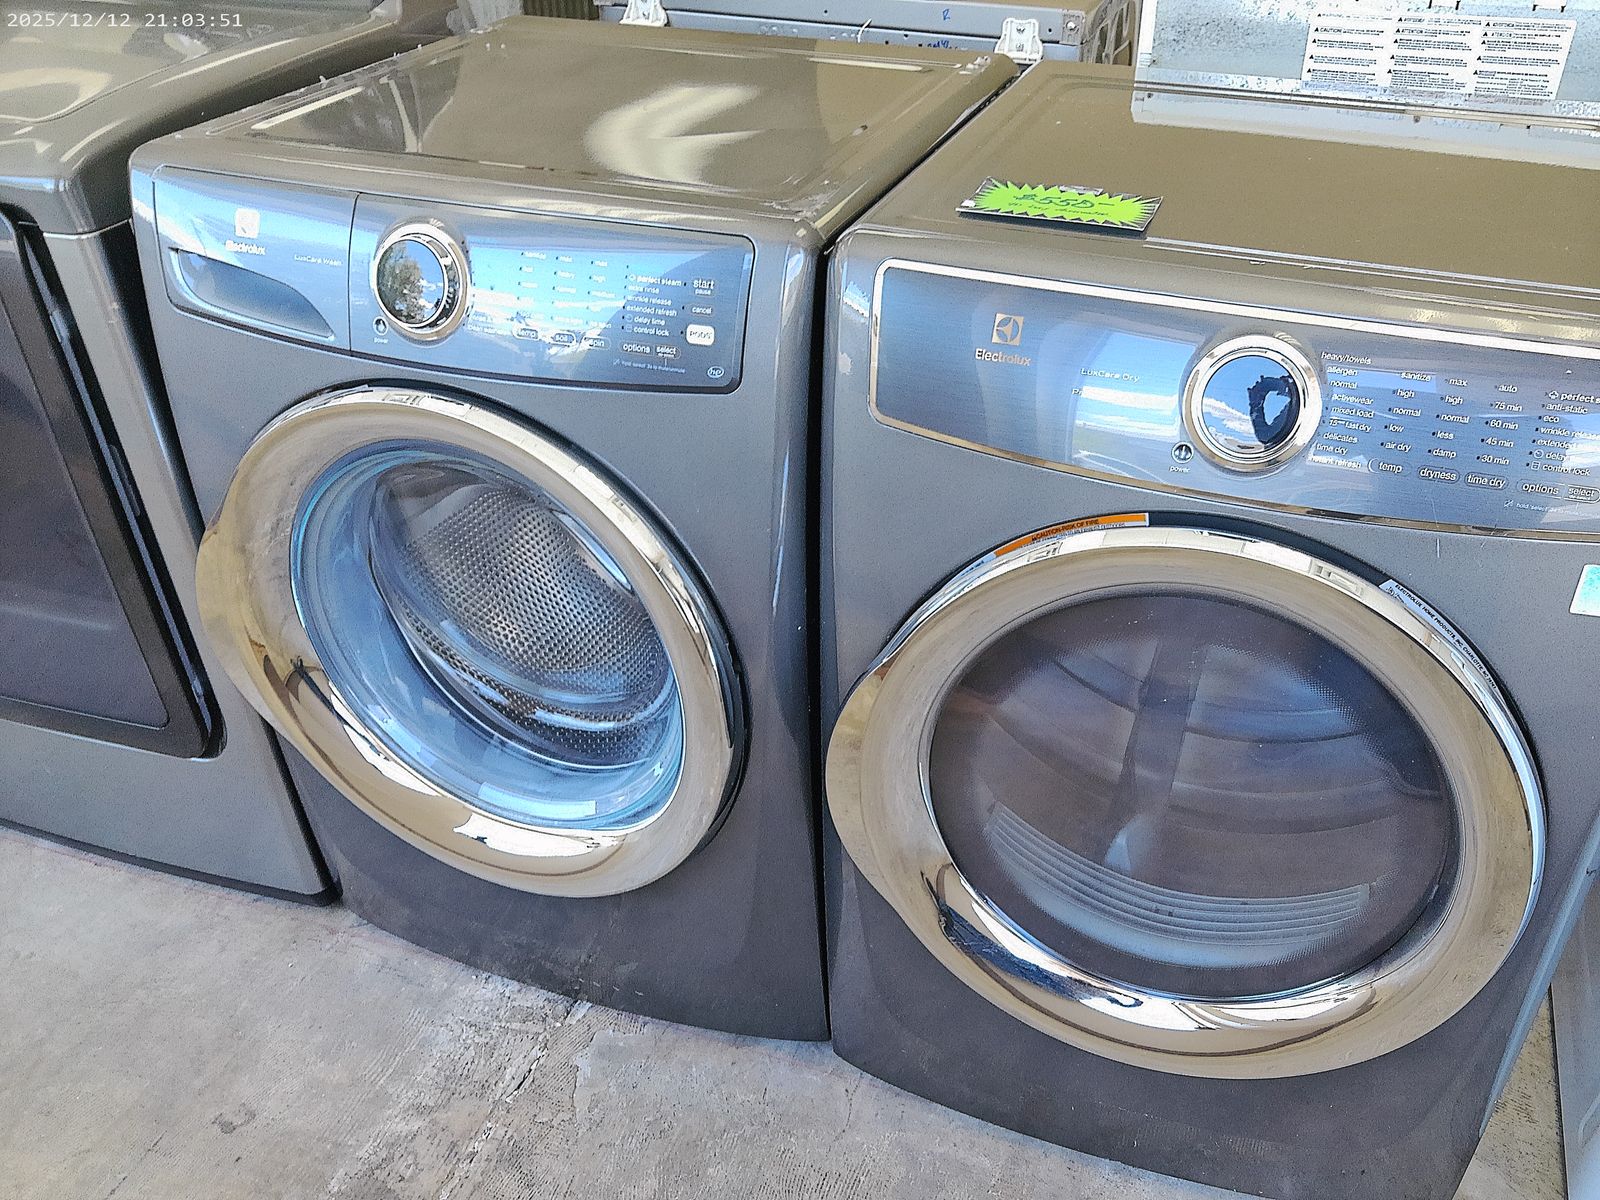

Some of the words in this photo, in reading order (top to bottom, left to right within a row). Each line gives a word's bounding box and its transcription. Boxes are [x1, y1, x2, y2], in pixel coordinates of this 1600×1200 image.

[693, 279, 715, 290] start
[626, 304, 655, 314] extended
[656, 307, 677, 317] refresh
[692, 306, 712, 315] cancel
[634, 316, 651, 326] delay
[633, 326, 655, 336] control
[656, 328, 669, 337] lock
[622, 342, 651, 354] options
[656, 345, 677, 355] select
[975, 348, 1032, 367] Electrolux
[1321, 351, 1372, 366] heavy/towels
[1081, 367, 1120, 380] LuxCare
[1122, 373, 1141, 383] Dry
[1327, 366, 1358, 377] allergen
[1401, 371, 1431, 382] sanitize
[1330, 380, 1358, 390] normal
[1449, 378, 1468, 387] max
[1397, 388, 1415, 399] high
[1498, 384, 1518, 394] auto
[1331, 393, 1374, 406] activewear
[1444, 395, 1463, 405] high
[1560, 392, 1594, 404] perfect
[1331, 406, 1356, 417] mixed
[1356, 409, 1375, 419] load
[1393, 407, 1421, 417] normal
[1494, 402, 1506, 410] 75
[1506, 403, 1523, 412] min
[1546, 403, 1588, 415] anti-static
[1440, 414, 1470, 424] normal
[1543, 414, 1560, 423] eco
[1389, 423, 1405, 433] low
[1490, 419, 1501, 428] 60
[1502, 421, 1519, 430] min
[1436, 431, 1454, 440] less
[1540, 426, 1570, 437] wrinkle
[1323, 431, 1358, 444] delicates
[1485, 437, 1497, 446] 45
[1498, 438, 1514, 448] min
[1316, 443, 1333, 452] time
[1334, 446, 1349, 456] dry
[1385, 441, 1396, 450] air
[1397, 443, 1411, 453] dry
[1432, 448, 1457, 459] damp
[1481, 454, 1493, 463] 30
[1493, 456, 1510, 465] min
[1379, 462, 1403, 474] temp
[1542, 463, 1572, 474] control
[1572, 466, 1590, 476] lock
[1420, 467, 1457, 481] dryness
[1467, 474, 1488, 485] time
[1489, 476, 1506, 489] dry
[1522, 482, 1559, 495] options
[1568, 487, 1595, 497] select
